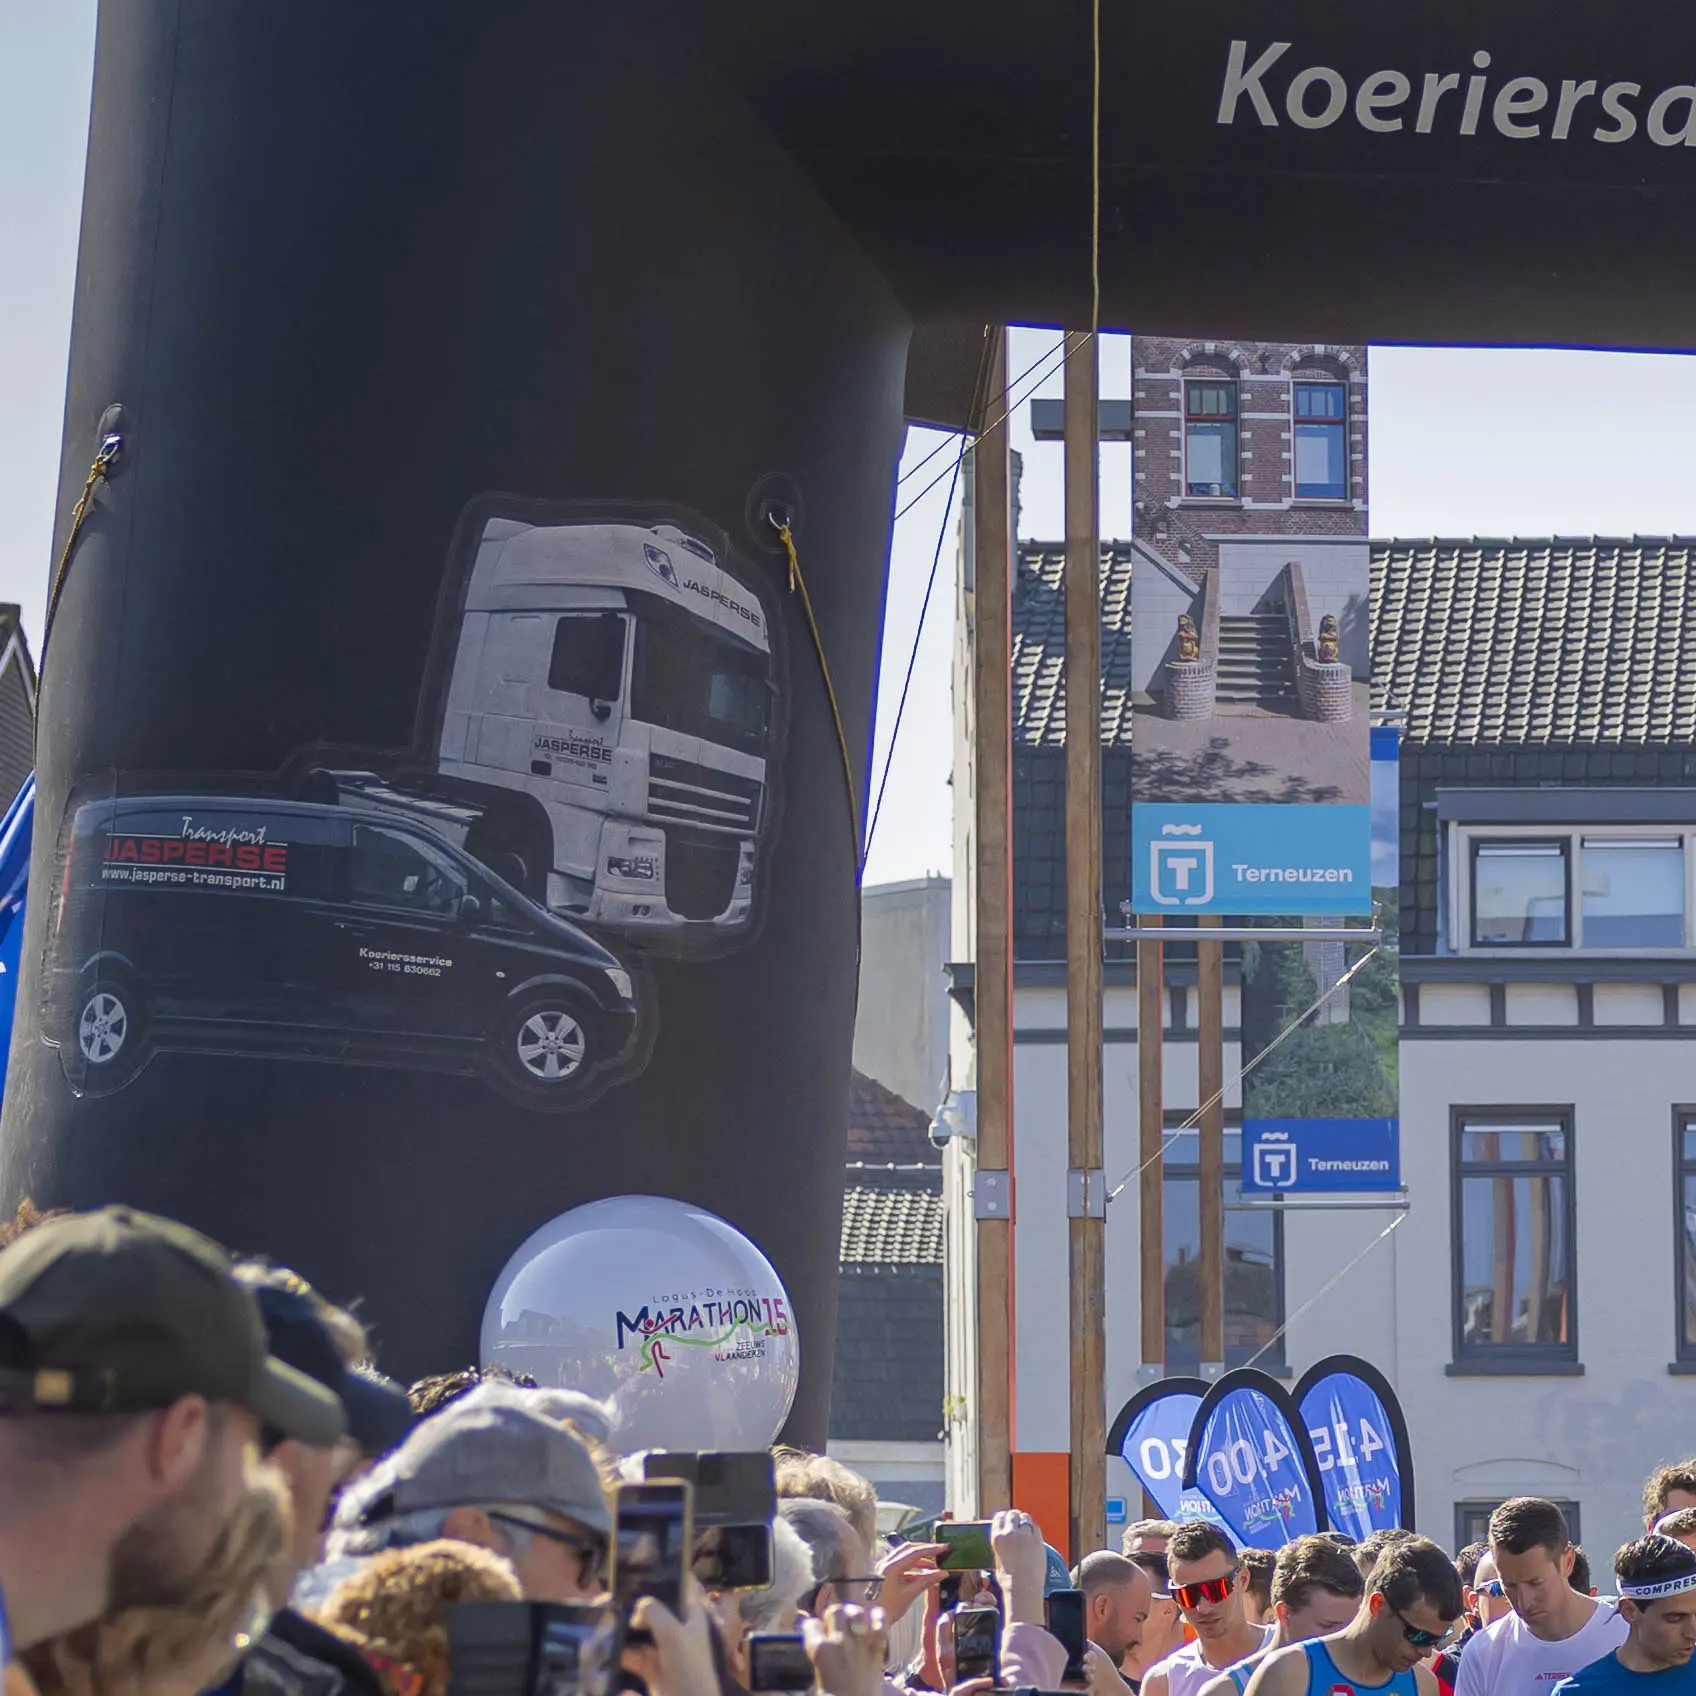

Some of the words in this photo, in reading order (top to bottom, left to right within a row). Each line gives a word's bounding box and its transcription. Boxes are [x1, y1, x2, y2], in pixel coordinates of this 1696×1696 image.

[683, 579, 762, 628] JASPERSE
[534, 737, 612, 762] JASPERSE
[181, 816, 267, 848] Transport
[104, 838, 289, 871] JASPERSE
[102, 867, 286, 891] www.jasperse-transport.nl
[1232, 863, 1353, 884] Terneuzen
[1308, 1157, 1389, 1172] Terneuzen
[616, 1299, 762, 1350] MARATHON
[762, 1298, 789, 1336] 15
